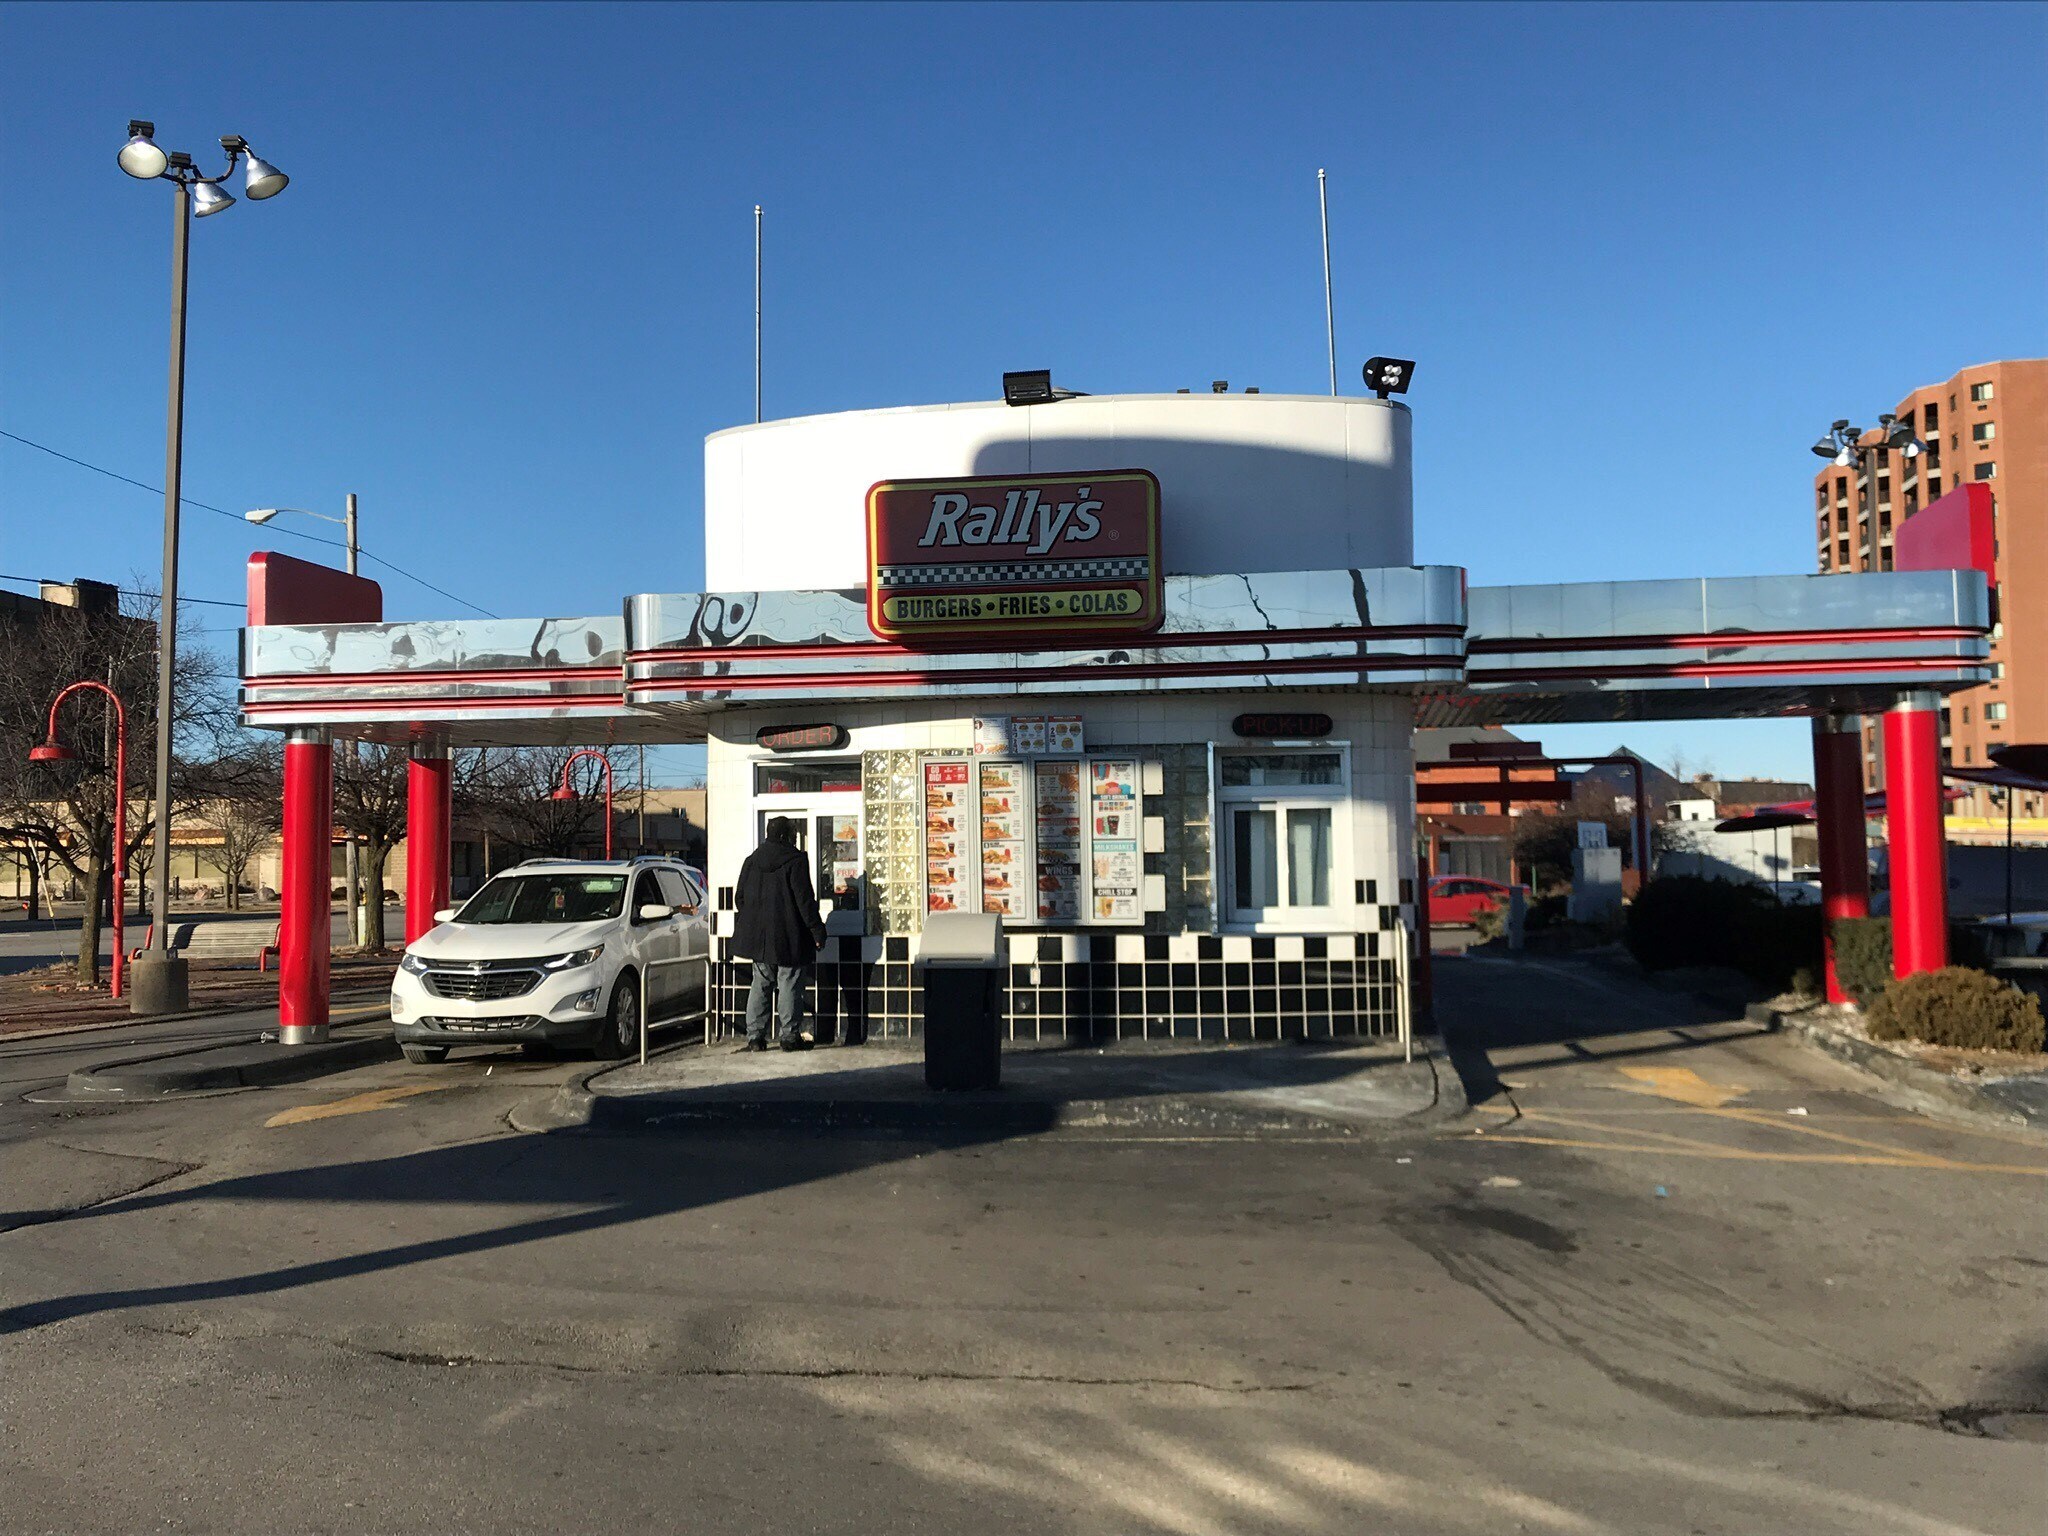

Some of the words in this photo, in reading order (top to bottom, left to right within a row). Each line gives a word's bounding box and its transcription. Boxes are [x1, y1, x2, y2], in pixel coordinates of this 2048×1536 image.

[917, 487, 1104, 555] Rally's
[896, 597, 982, 620] BURGERS
[999, 595, 1051, 616] FRIES
[1069, 592, 1128, 613] COLAS
[762, 725, 832, 747] ORDER
[1094, 843, 1135, 851] MILKSHAKES
[1045, 866, 1074, 875] WINGS
